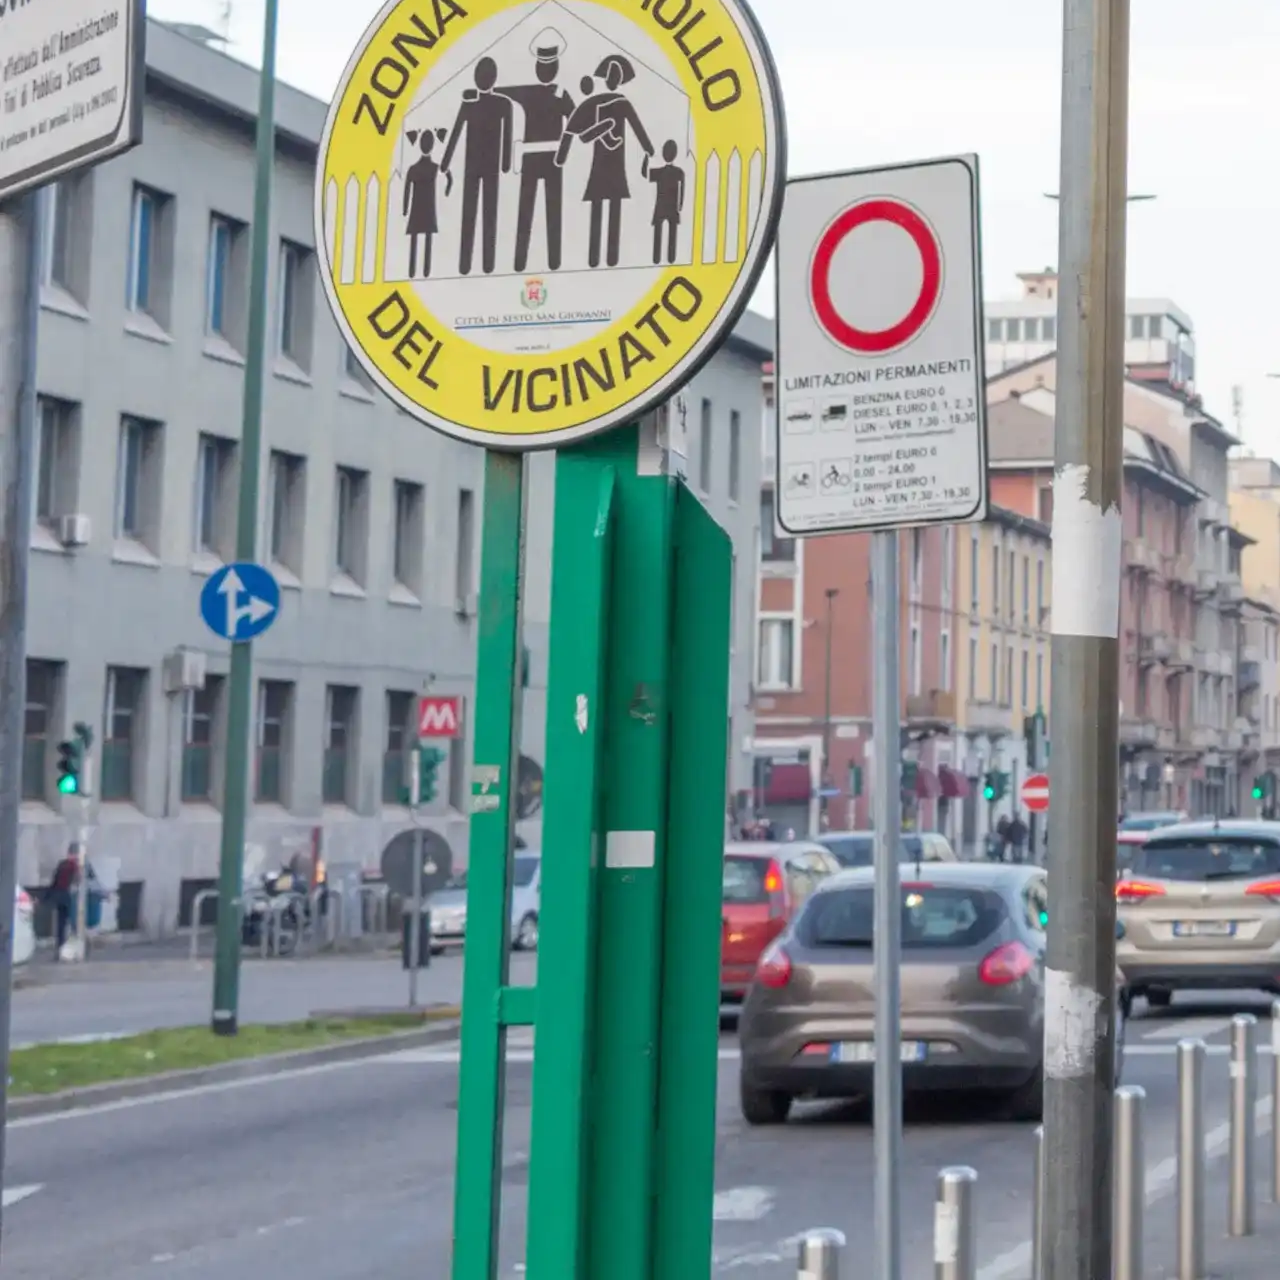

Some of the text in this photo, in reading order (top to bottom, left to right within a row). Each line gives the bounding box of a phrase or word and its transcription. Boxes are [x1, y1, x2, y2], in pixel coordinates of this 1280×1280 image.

[366, 275, 704, 413] DEL VICINATO
[785, 359, 971, 391] LIMITAZIONI PERMANENTI
[854, 391, 902, 405] BENZINA
[904, 387, 936, 400] EURO
[854, 405, 892, 419] DIESEL
[896, 402, 927, 415] EURO
[854, 422, 876, 434] LUN
[889, 419, 911, 431] VEN
[895, 448, 927, 460] EURO
[895, 477, 928, 489] EURO
[853, 496, 875, 508] LUN
[885, 493, 908, 505] VEN
[421, 703, 456, 730] M
